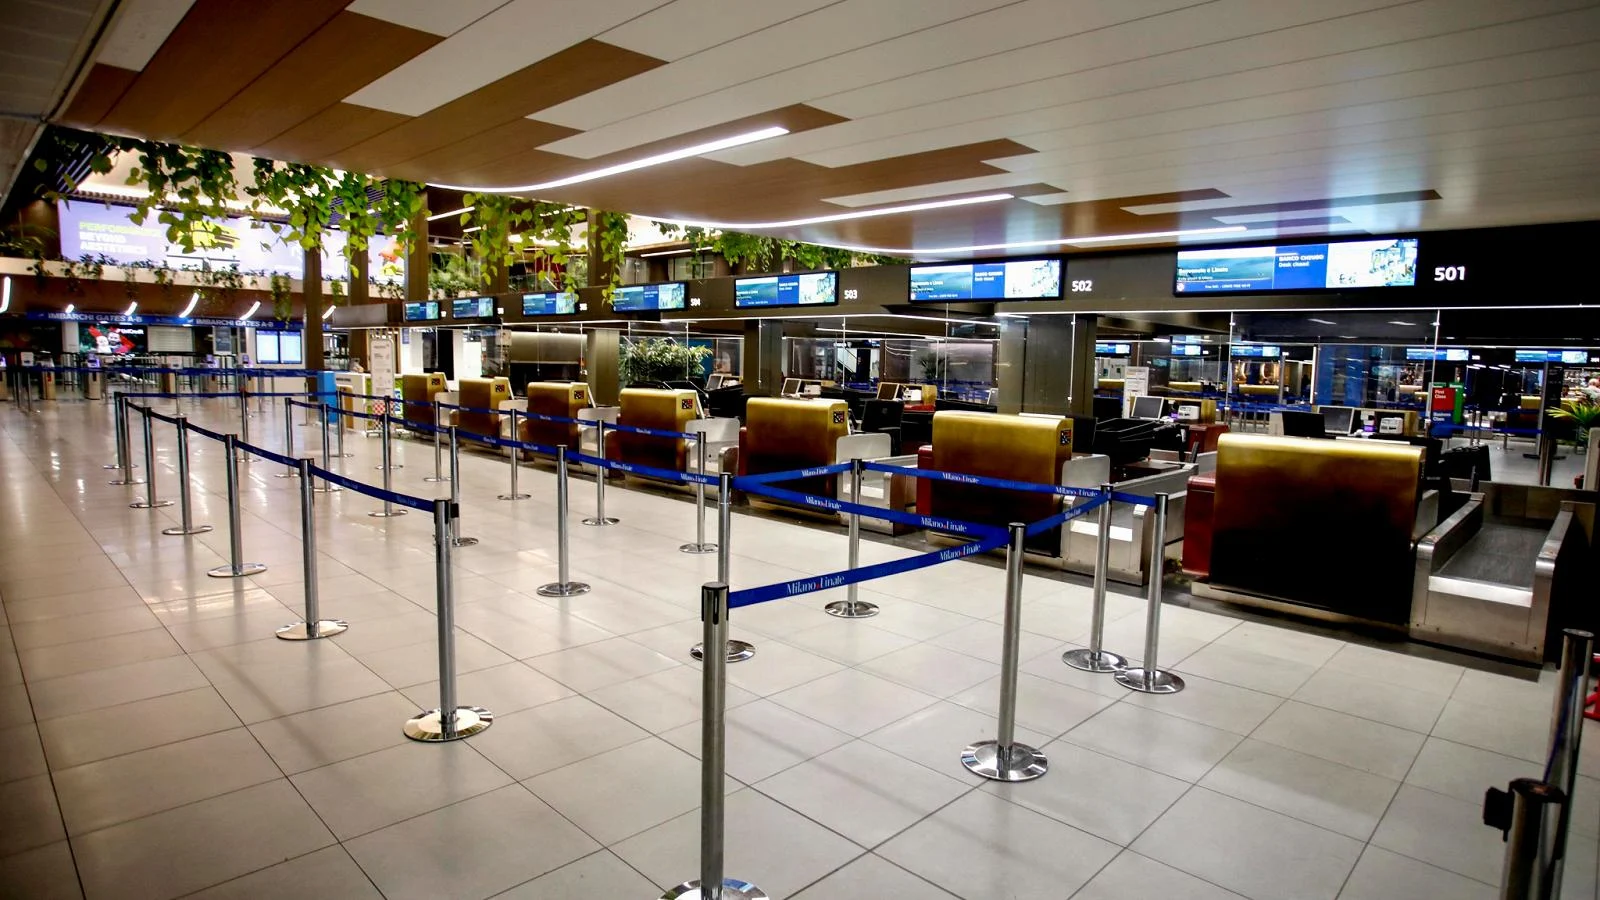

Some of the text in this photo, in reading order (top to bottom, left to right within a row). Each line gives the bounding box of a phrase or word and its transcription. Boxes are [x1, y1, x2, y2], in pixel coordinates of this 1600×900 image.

[1434, 266, 1465, 281] 501
[1071, 280, 1093, 292] 502
[844, 289, 858, 299] 503
[920, 516, 967, 532] Milano Linate
[940, 544, 981, 561] Milano Linate
[786, 575, 845, 595] Milano Linate
